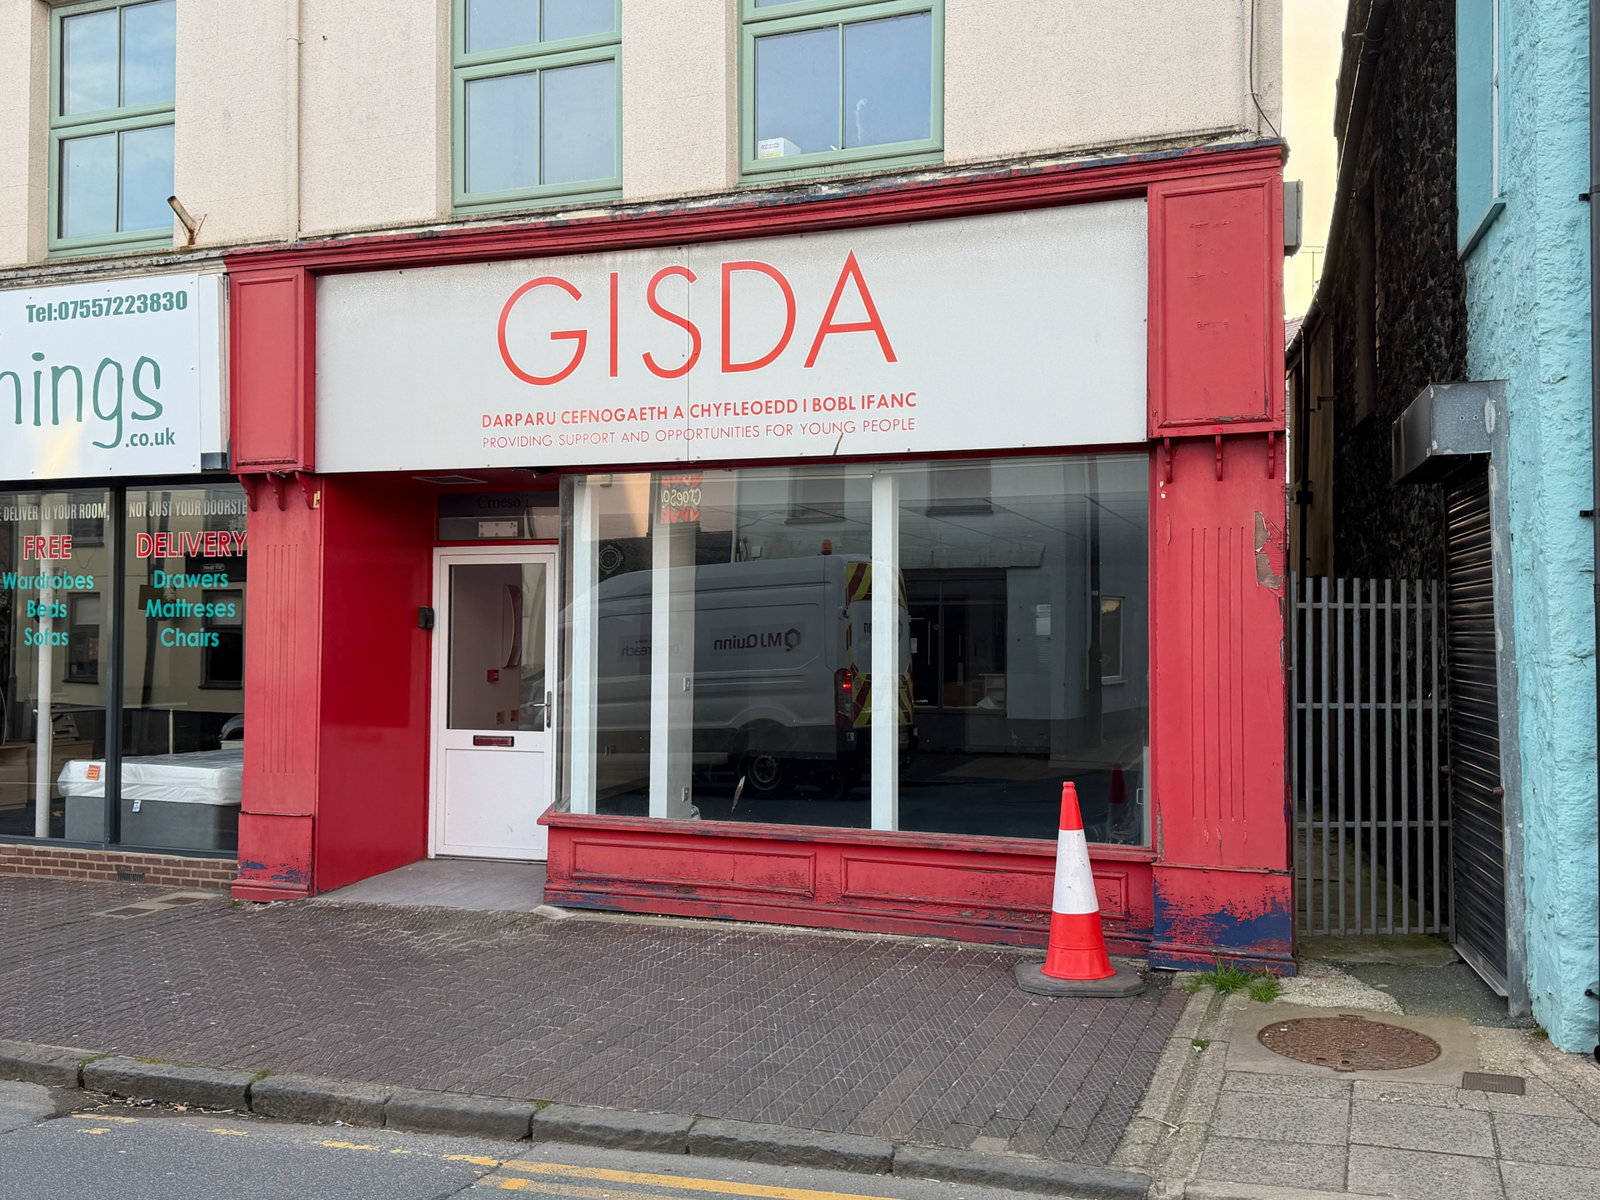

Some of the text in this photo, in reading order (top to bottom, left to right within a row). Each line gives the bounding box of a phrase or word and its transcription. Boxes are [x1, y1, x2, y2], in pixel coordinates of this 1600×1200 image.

[26, 290, 188, 323] Tel:07557223830
[498, 249, 898, 386] GISDA
[481, 392, 917, 428] DARPARU CEFNOGAETH A CHYFLEOEDD I BOBL IFANC
[125, 427, 175, 448] .co.uk
[482, 417, 915, 449] PROVIDING SUPPORT AND OPPORTUNITIES FOR YOUNG PEOPLE
[3, 505, 39, 521] DELIVER
[41, 504, 51, 520] TO
[53, 503, 77, 520] YOUR
[79, 502, 110, 521] ROOM,
[128, 498, 248, 518] NOT JUST YOUR DOORSTE
[23, 535, 73, 560] FREE
[136, 531, 247, 559] DELIVERY
[2, 572, 94, 590] Wardrobes
[153, 570, 229, 589] Drawers
[27, 600, 67, 618] Beds
[145, 599, 236, 618] Mattreses
[24, 628, 69, 646] Sofas
[160, 628, 220, 647] Chairs
